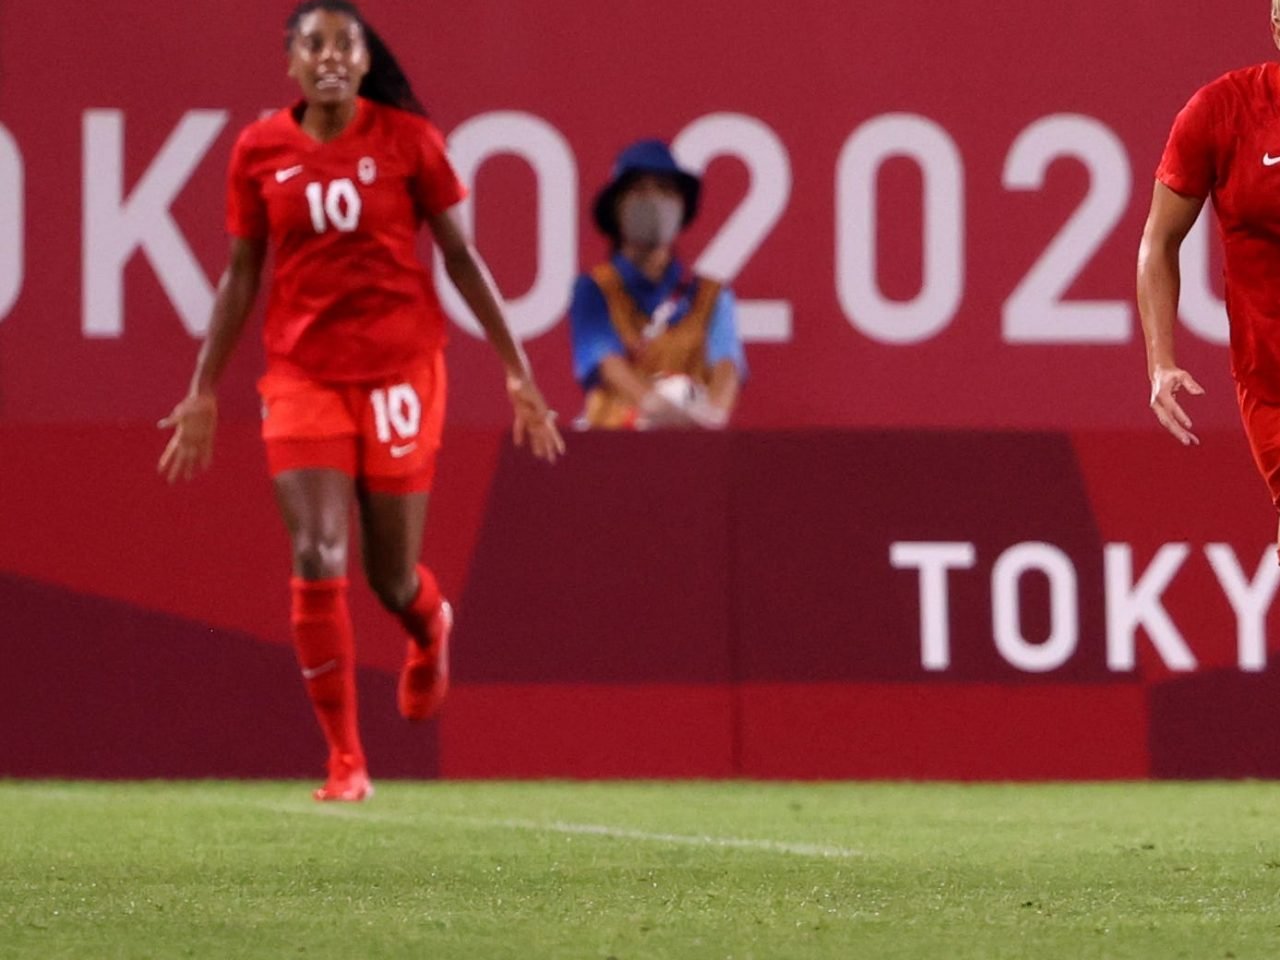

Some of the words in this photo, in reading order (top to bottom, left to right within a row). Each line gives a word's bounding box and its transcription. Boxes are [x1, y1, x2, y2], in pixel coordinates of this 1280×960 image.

[0, 110, 578, 338] KO
[662, 111, 1231, 344] 202
[305, 178, 362, 234] 10
[370, 382, 421, 443] 10
